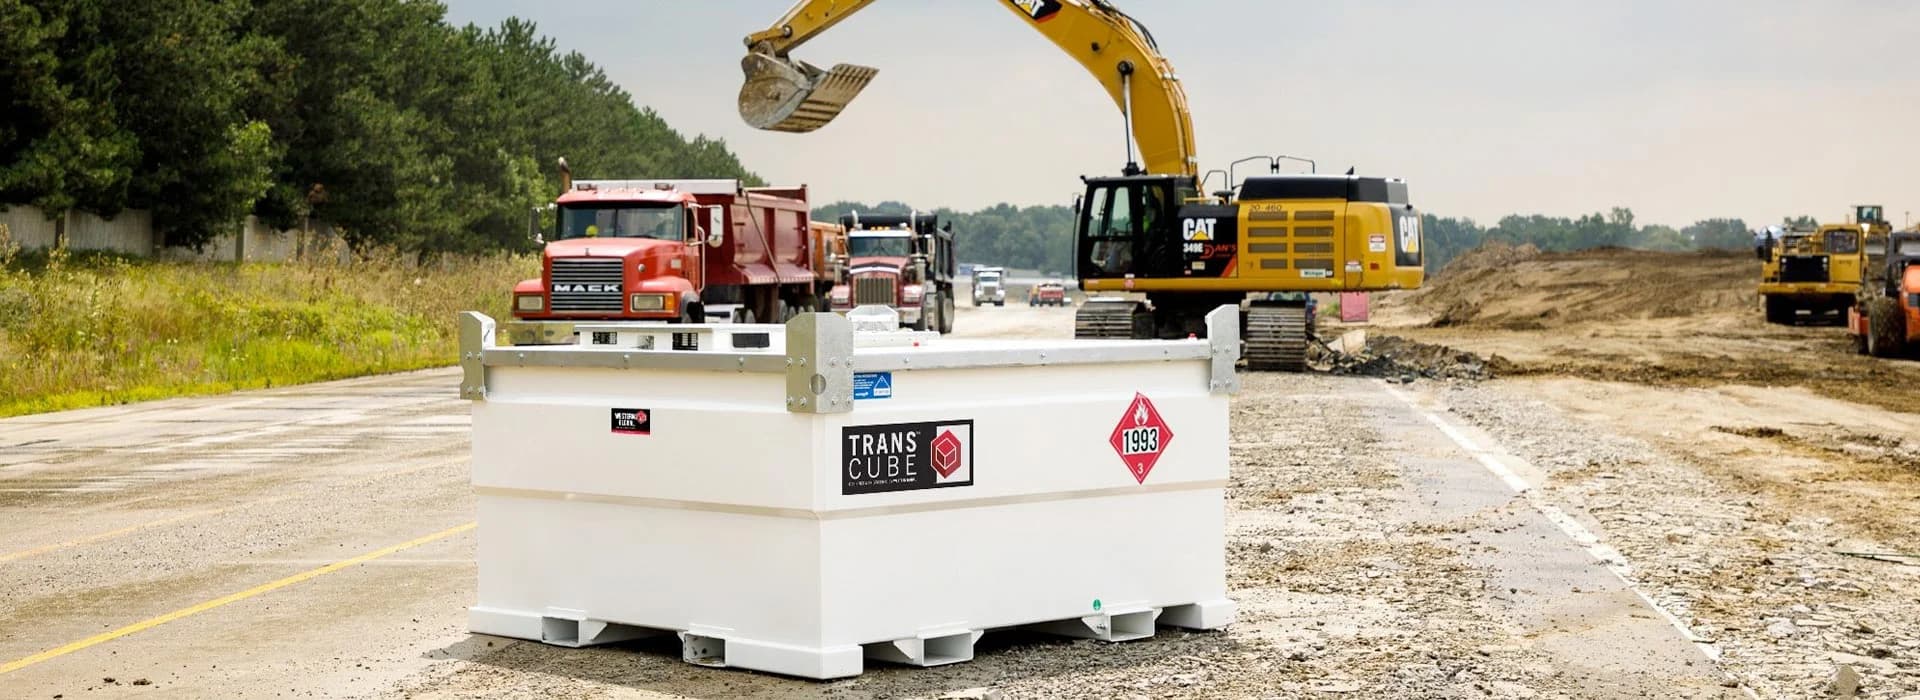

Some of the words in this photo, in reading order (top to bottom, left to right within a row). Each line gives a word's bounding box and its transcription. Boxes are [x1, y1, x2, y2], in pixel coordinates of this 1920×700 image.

[1183, 218, 1217, 241] CAT
[1183, 242, 1204, 253] 349E
[553, 284, 620, 292] MACK
[848, 430, 918, 456] TRANS
[1124, 428, 1158, 454] 1993
[848, 454, 917, 480] CUBE
[1137, 462, 1144, 475] 3
